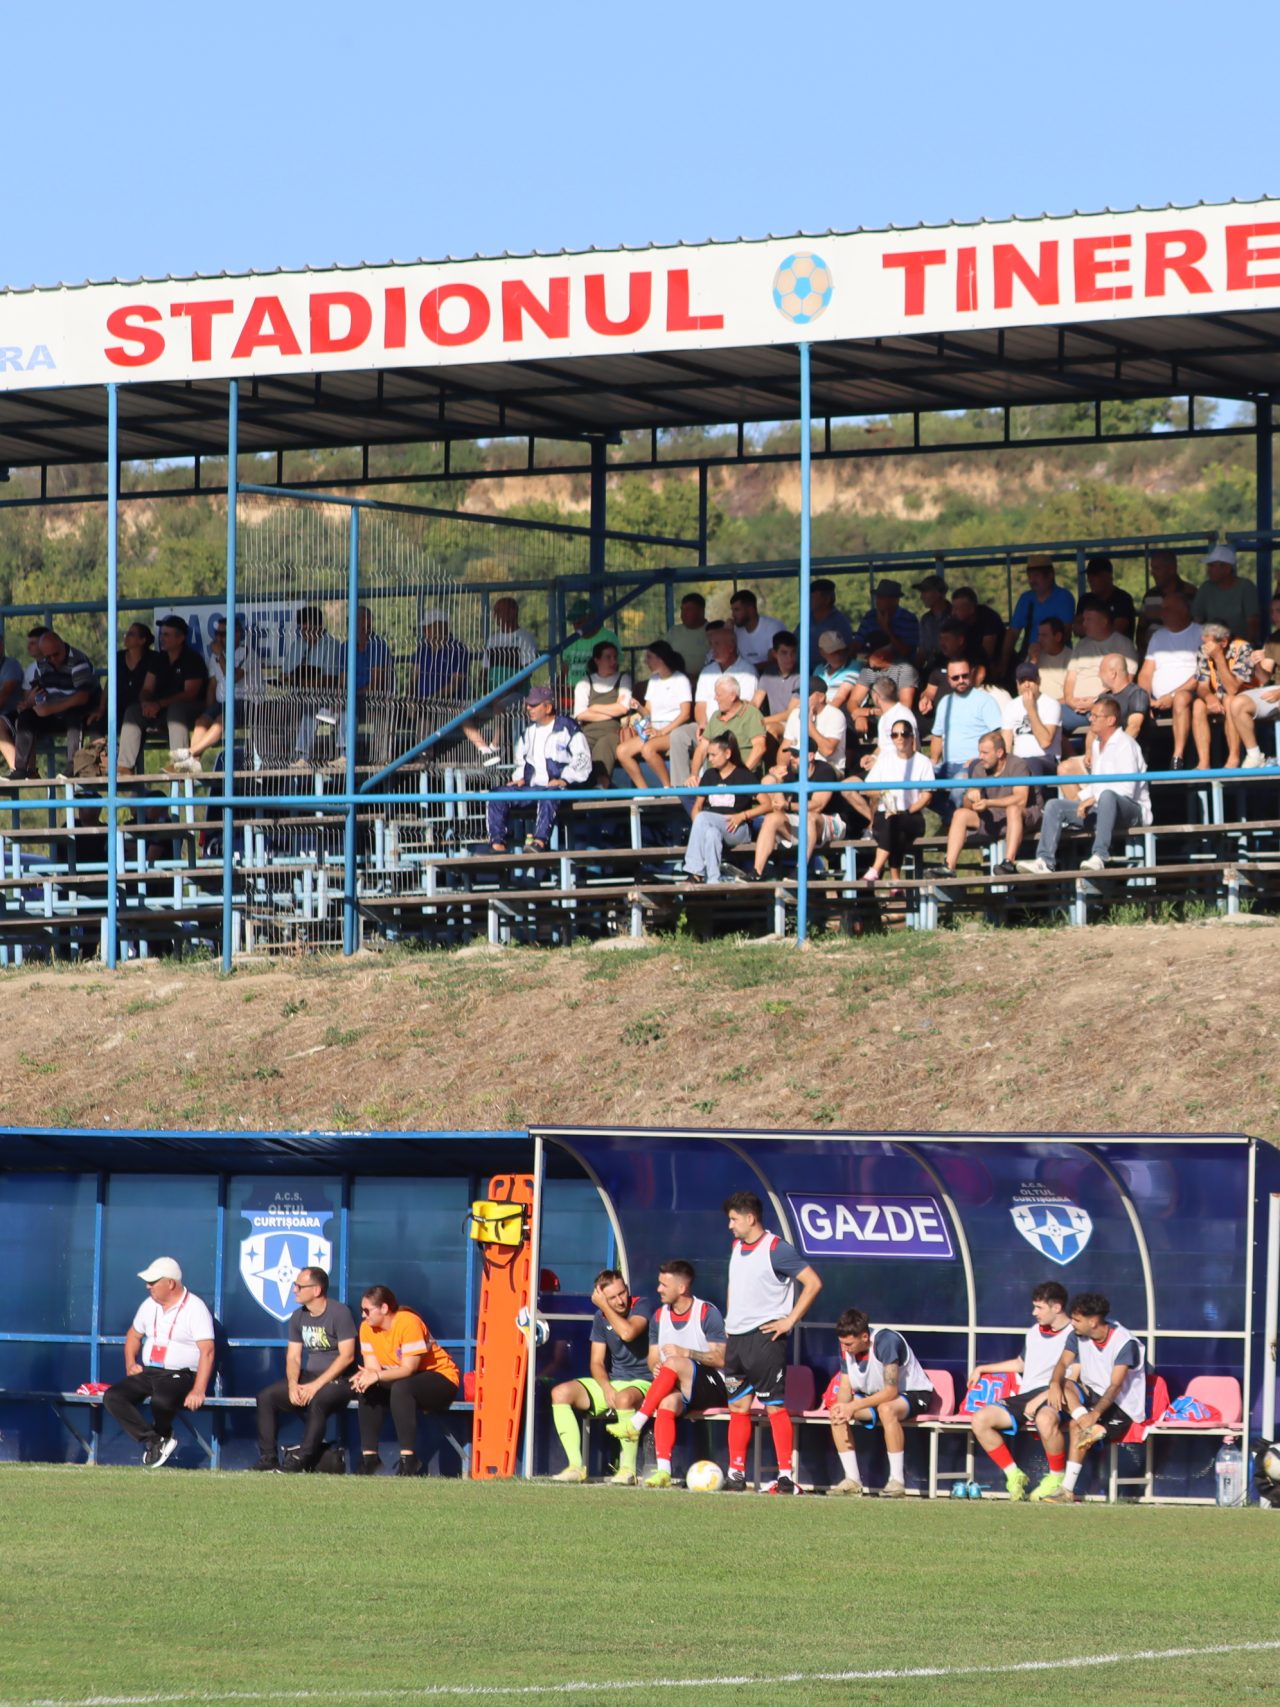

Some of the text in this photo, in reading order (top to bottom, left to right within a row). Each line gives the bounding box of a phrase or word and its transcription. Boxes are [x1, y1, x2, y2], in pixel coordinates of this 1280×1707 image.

[104, 268, 725, 368] STADIONUL
[268, 1204, 308, 1216] OLTUL
[274, 1192, 303, 1202] A.C.S.
[800, 1203, 945, 1243] GAZDE
